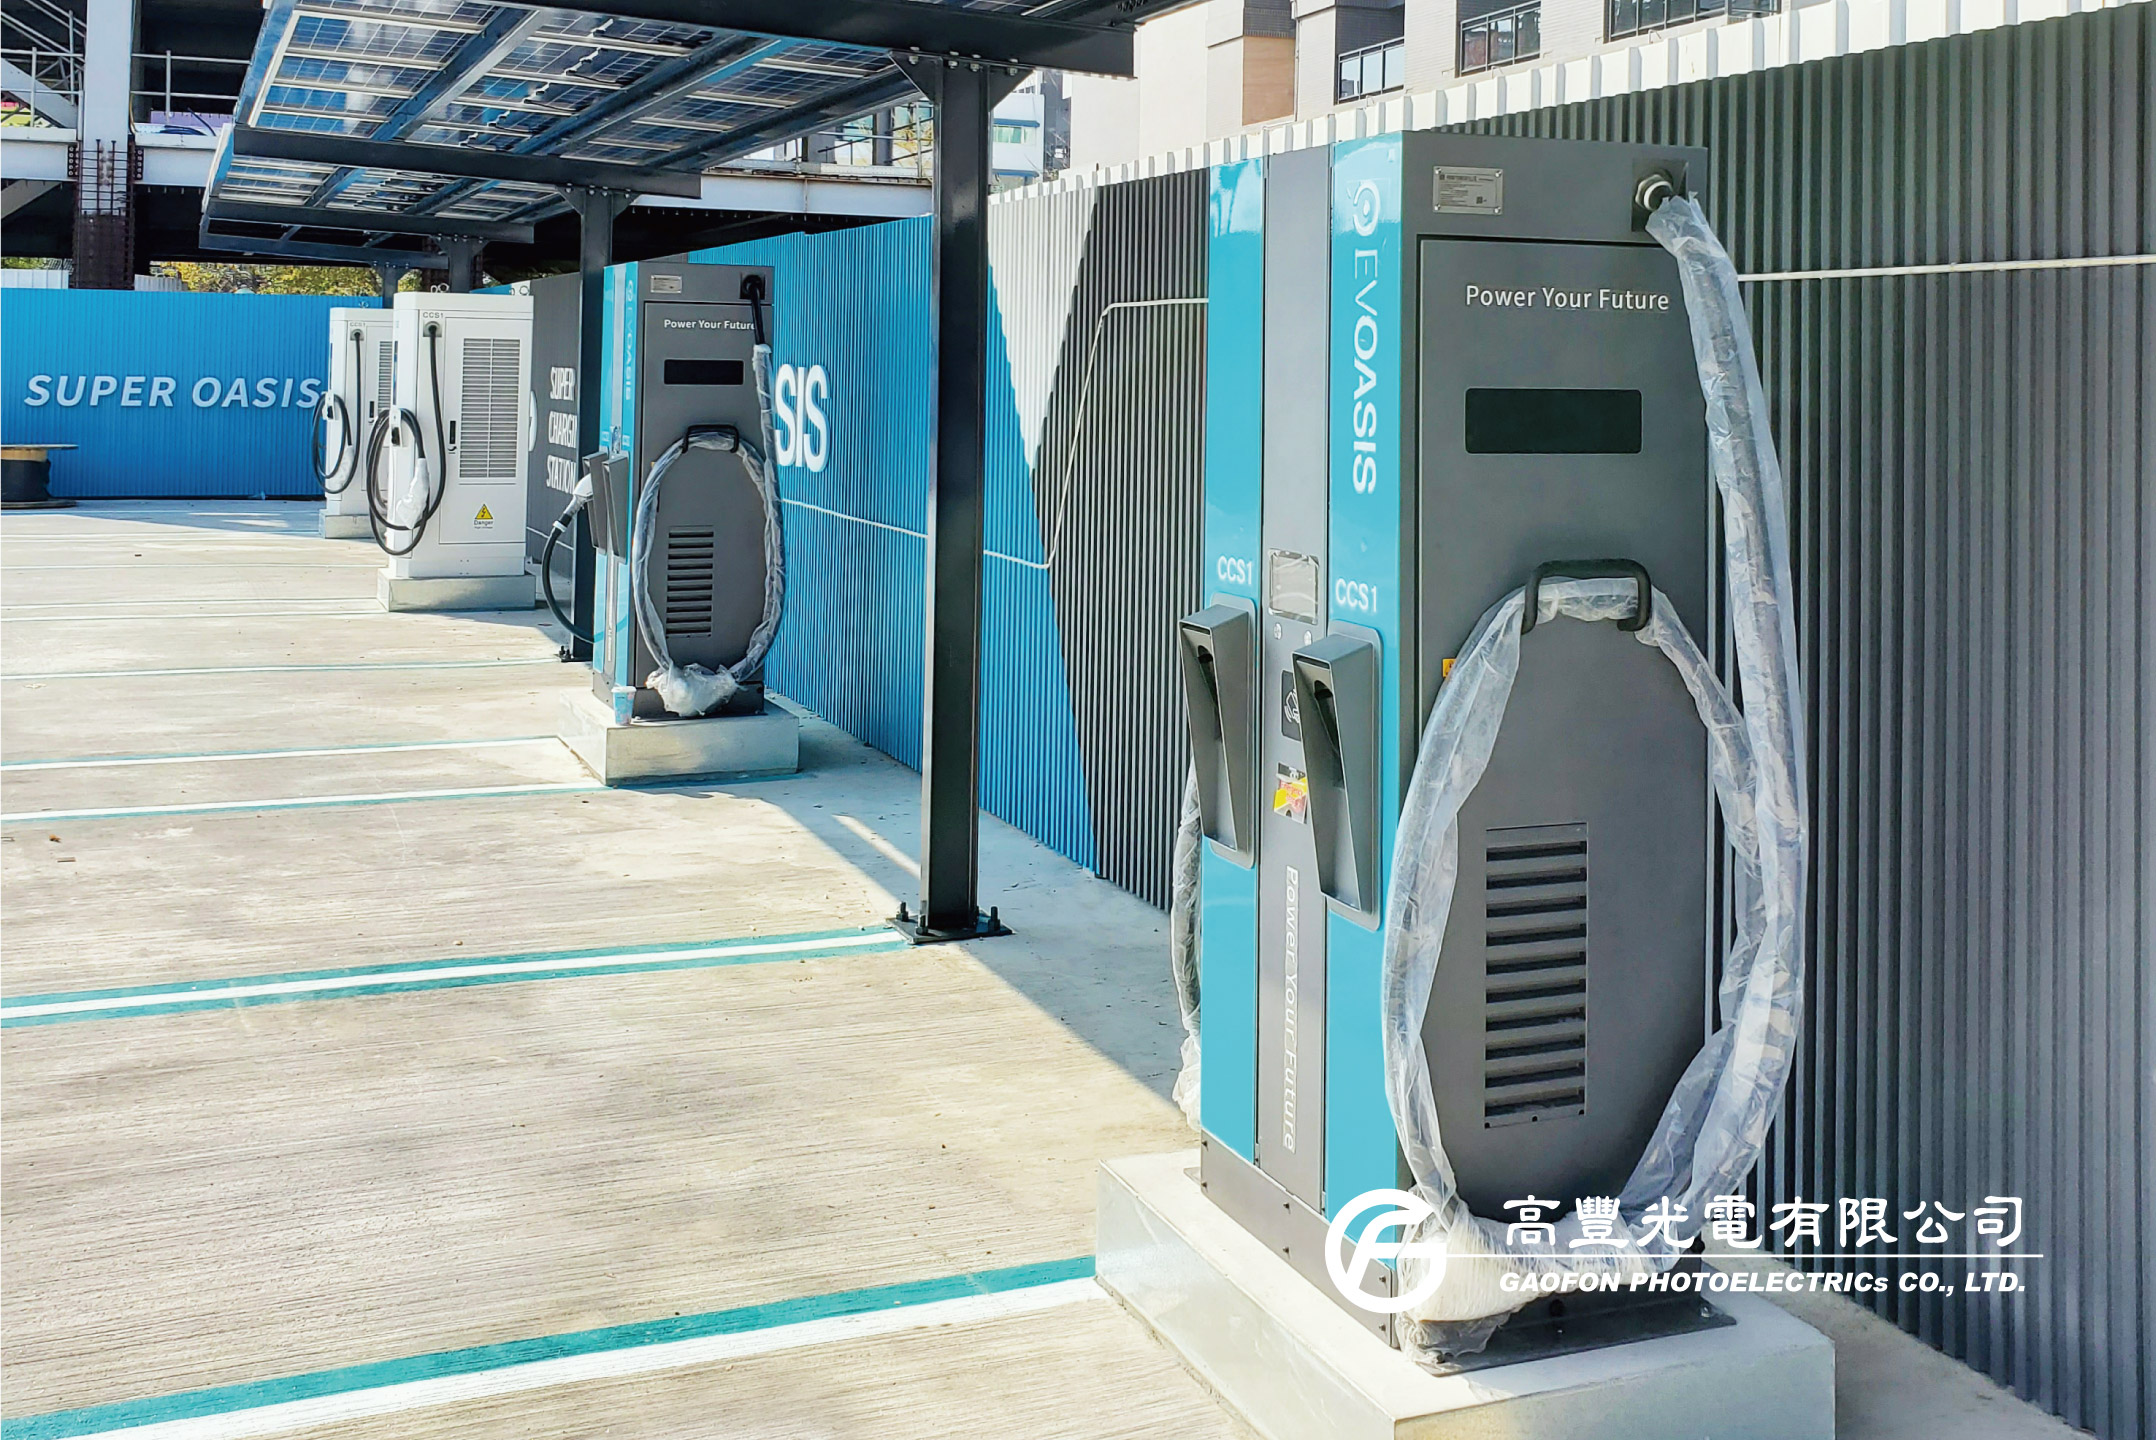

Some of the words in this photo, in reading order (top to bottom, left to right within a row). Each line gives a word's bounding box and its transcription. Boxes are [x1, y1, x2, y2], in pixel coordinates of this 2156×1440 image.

[1466, 285, 1536, 307] Power
[1542, 287, 1593, 309] Your
[1598, 289, 1670, 310] Future
[663, 319, 696, 329] Power
[698, 320, 722, 329] Your
[549, 366, 576, 401] SUPER
[1352, 249, 1378, 494] EVOASIS
[24, 375, 177, 407] SUPER
[192, 377, 322, 408] OASIS
[546, 454, 577, 495] STATION
[1217, 555, 1252, 584] CCS1
[1335, 578, 1377, 613] CCS1
